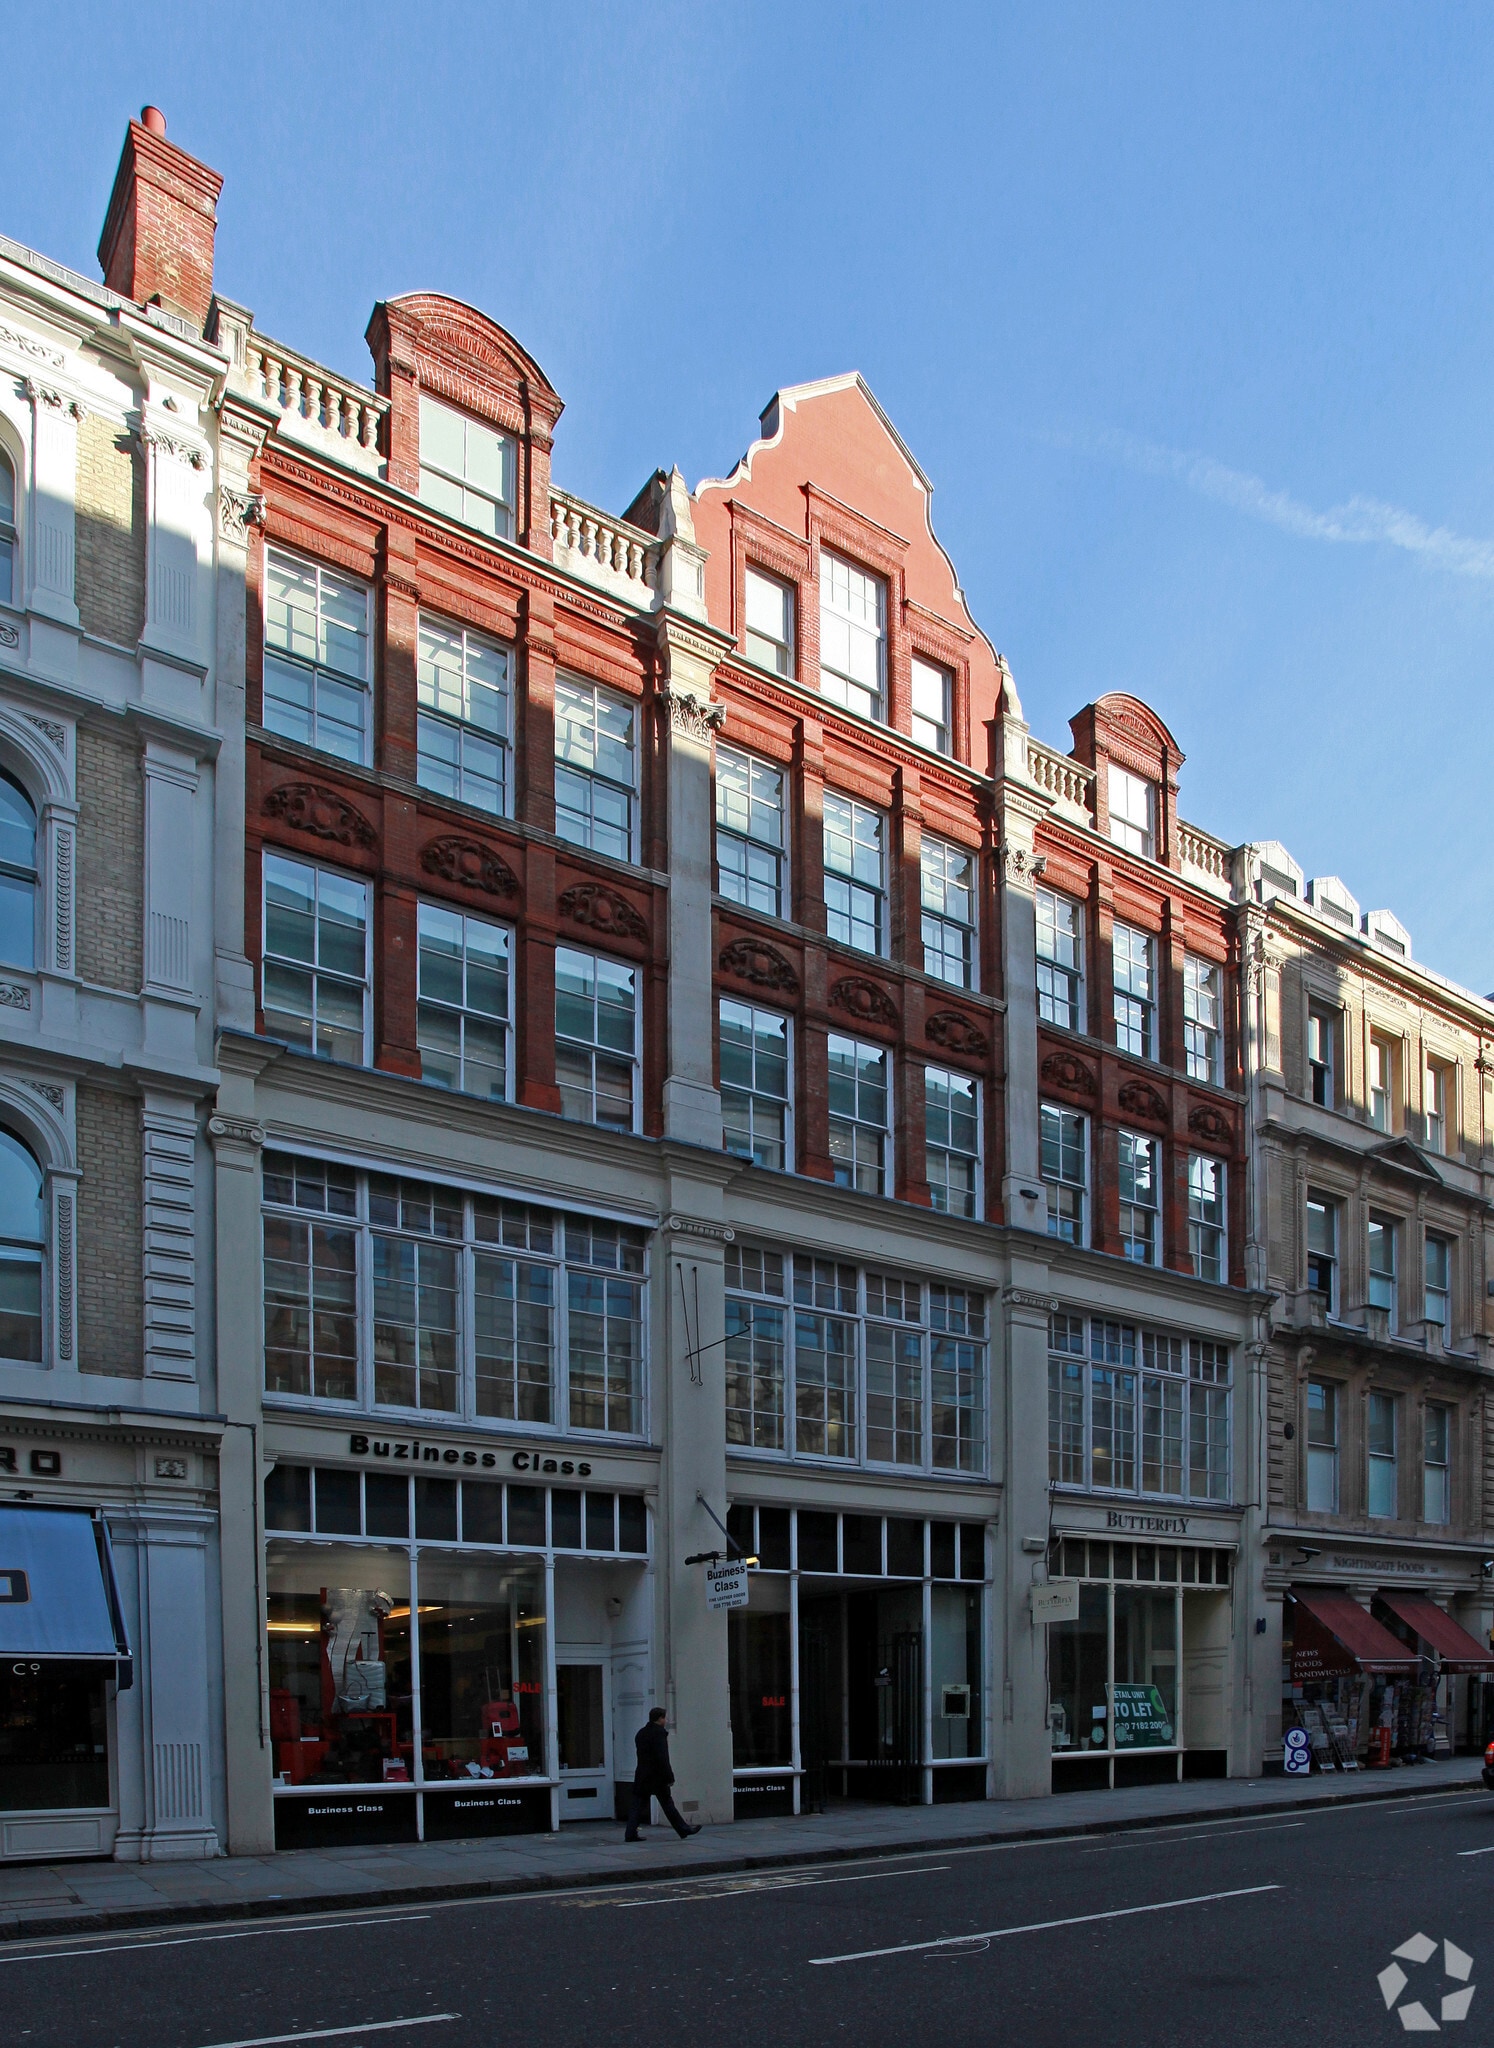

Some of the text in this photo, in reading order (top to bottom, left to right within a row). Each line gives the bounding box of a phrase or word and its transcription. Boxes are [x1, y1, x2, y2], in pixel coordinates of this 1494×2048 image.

[350, 1434, 592, 1476] Buziness Class
[1107, 1511, 1189, 1533] BUTTERFLY
[707, 1565, 745, 1580] Buziness
[714, 1580, 739, 1592] Class
[1295, 1650, 1319, 1658] NEWS
[1294, 1660, 1323, 1668] FOODS
[513, 1682, 542, 1694] SALE
[761, 1695, 785, 1706] SALE
[1131, 1691, 1146, 1699] UNIT
[1114, 1702, 1152, 1717] TO LET
[733, 1785, 764, 1793] Buziness
[454, 1797, 522, 1807] Buziness Class
[308, 1804, 383, 1815] Buziness Class
